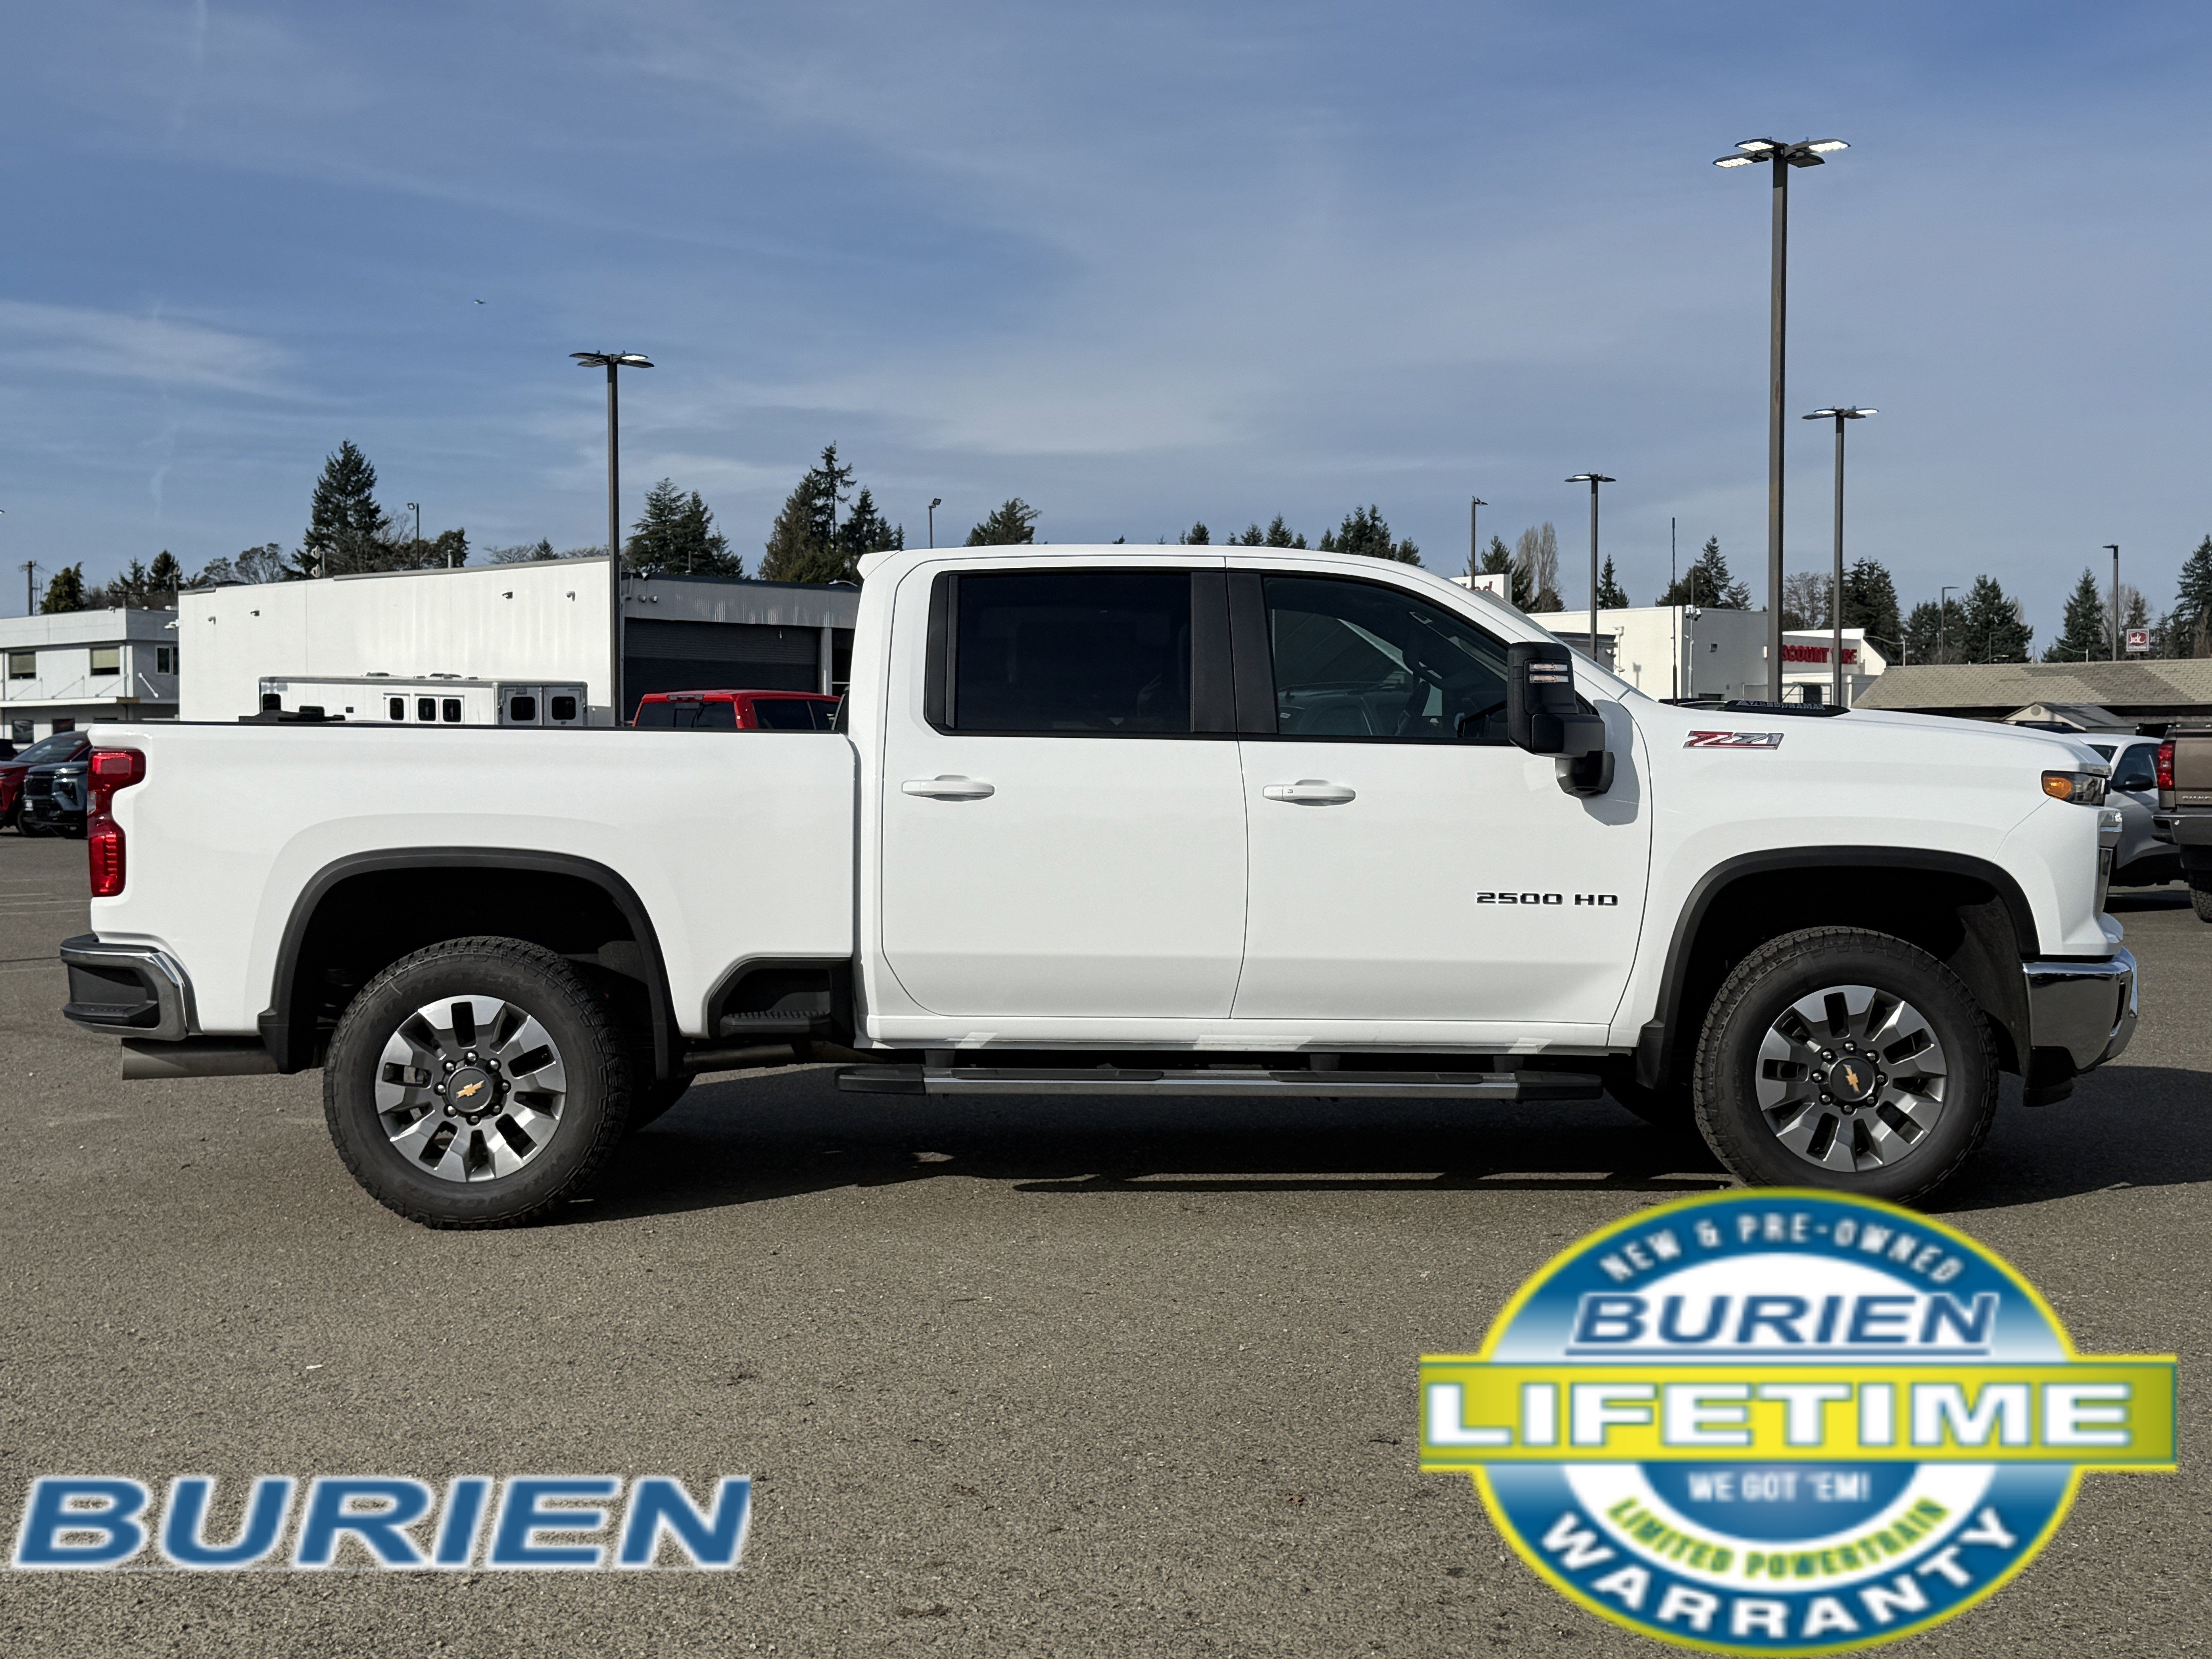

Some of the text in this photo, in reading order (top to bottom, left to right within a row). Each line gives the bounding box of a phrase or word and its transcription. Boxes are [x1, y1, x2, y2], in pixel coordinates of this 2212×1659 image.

[1782, 645, 1829, 663] SCOUNT
[1683, 730, 1784, 750] Z71
[1477, 892, 1618, 906] 2500 HD
